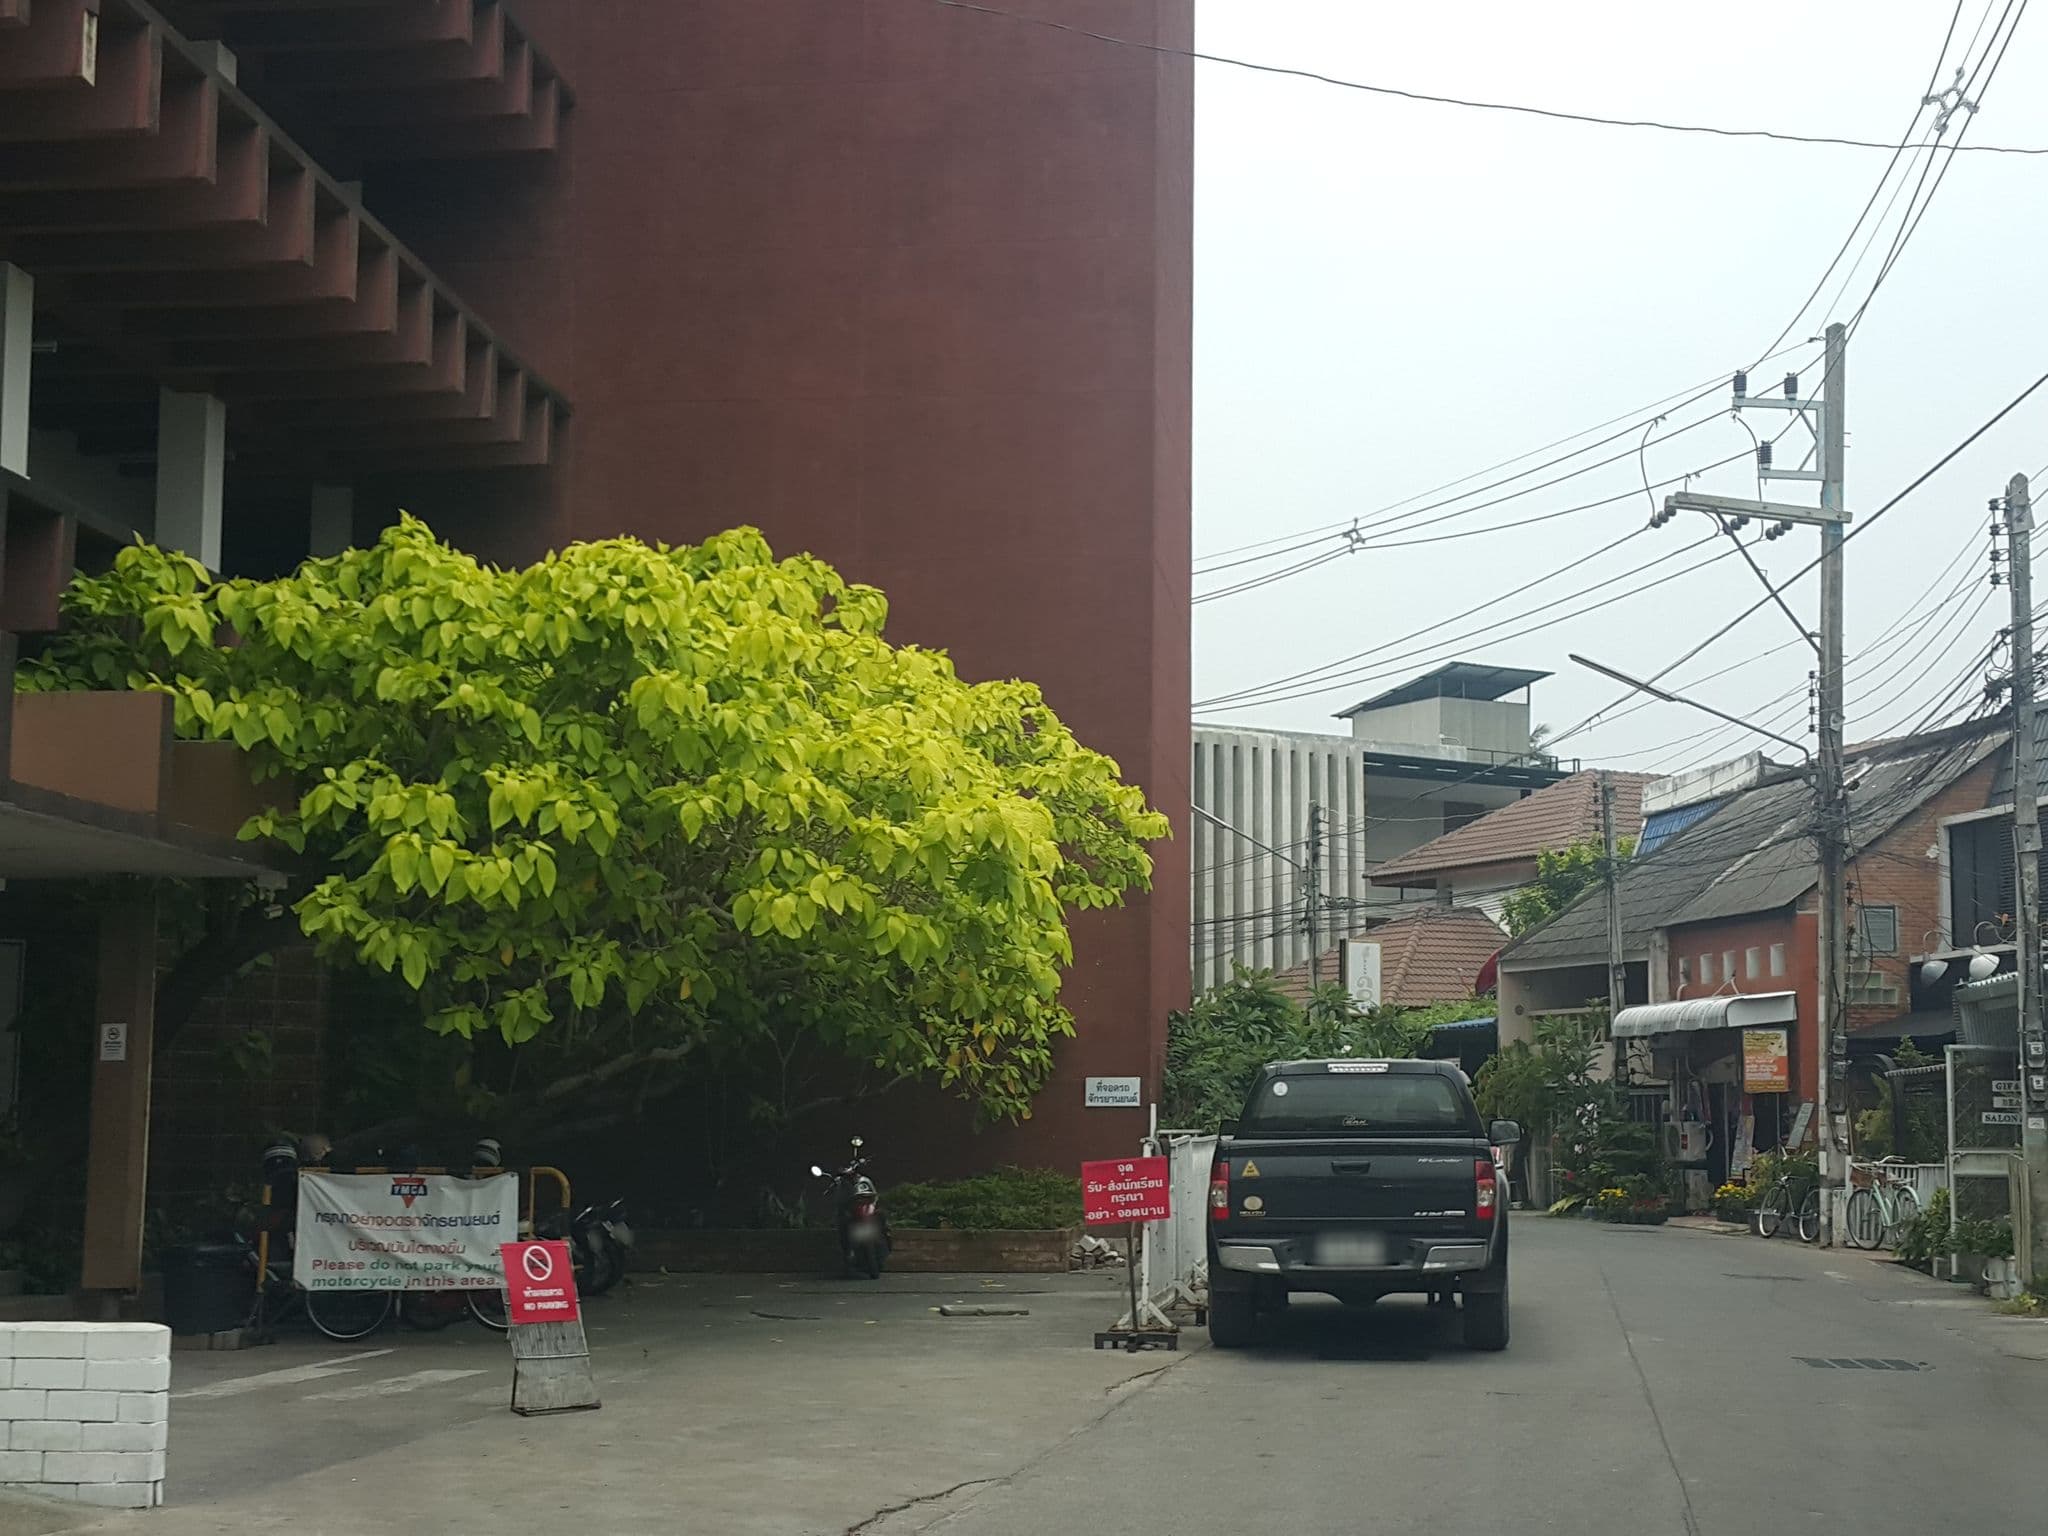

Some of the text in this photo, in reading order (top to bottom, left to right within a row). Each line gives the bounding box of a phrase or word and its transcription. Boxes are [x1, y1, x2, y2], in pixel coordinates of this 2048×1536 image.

[1088, 1092, 1138, 1104] จักรยานยนต์
[1985, 1114, 2017, 1122] SALON
[1117, 1164, 1134, 1176] จุด
[393, 1185, 426, 1195] YMCA
[1111, 1192, 1144, 1206] กรุณา
[312, 1258, 498, 1275] Please do not park your
[312, 1275, 401, 1290] motorcycle
[407, 1275, 421, 1286] in
[425, 1274, 456, 1287] this
[524, 1301, 569, 1310] NO PARKING
